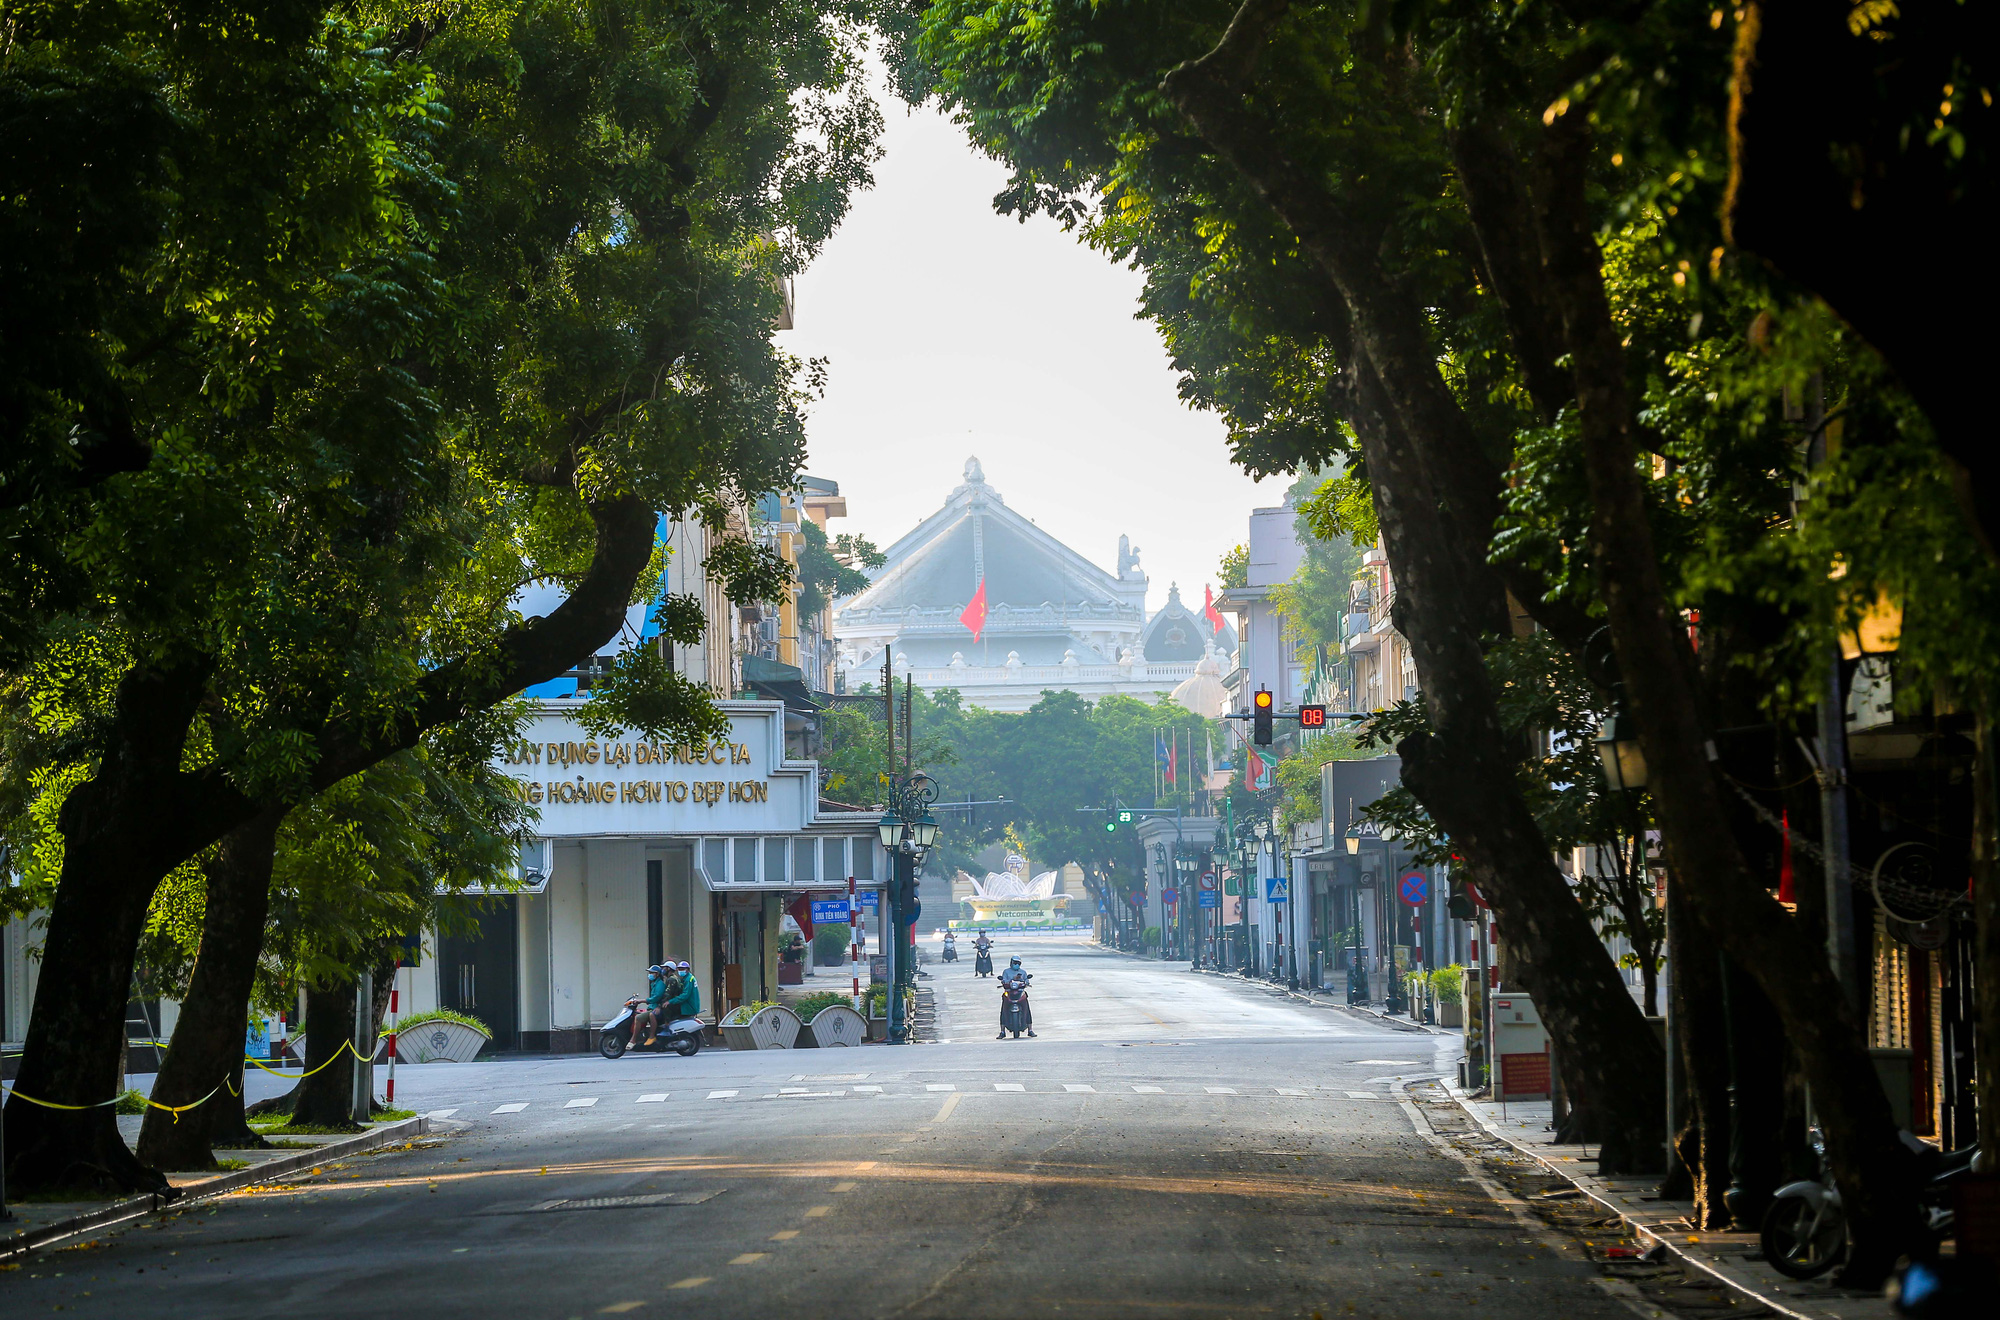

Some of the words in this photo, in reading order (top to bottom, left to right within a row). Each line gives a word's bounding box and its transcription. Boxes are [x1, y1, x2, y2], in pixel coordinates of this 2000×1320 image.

[1302, 709, 1324, 726] 08
[547, 741, 600, 770] DỰNG
[604, 742, 631, 769] LẠI
[729, 743, 751, 764] TA
[620, 780, 661, 804] HƠN
[665, 781, 689, 803] TO
[692, 781, 725, 808] ĐẸP
[728, 780, 768, 804] HƠN
[1119, 812, 1131, 822] 23
[996, 910, 1045, 918] Vietcombank
